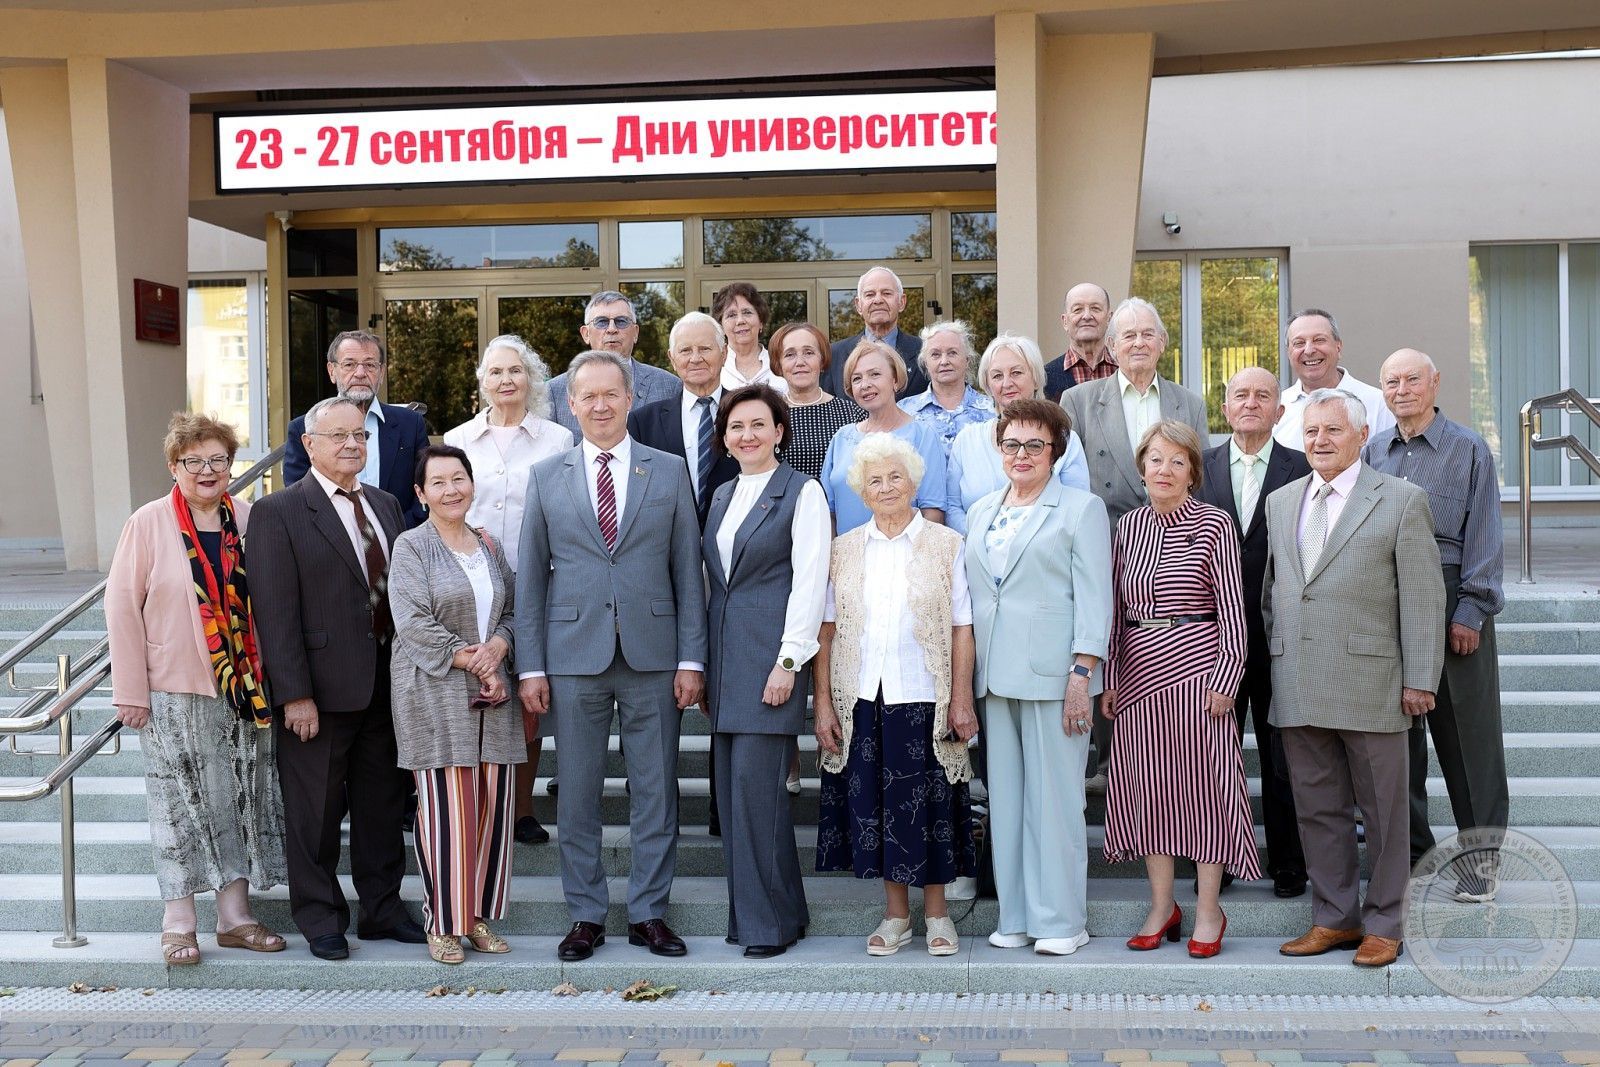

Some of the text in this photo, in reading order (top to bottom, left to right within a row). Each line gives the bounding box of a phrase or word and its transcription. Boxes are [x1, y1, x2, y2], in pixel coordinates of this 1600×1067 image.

[236, 128, 283, 169] 23
[317, 126, 359, 166] 27
[370, 120, 567, 165] сентября
[612, 115, 697, 163] Дни
